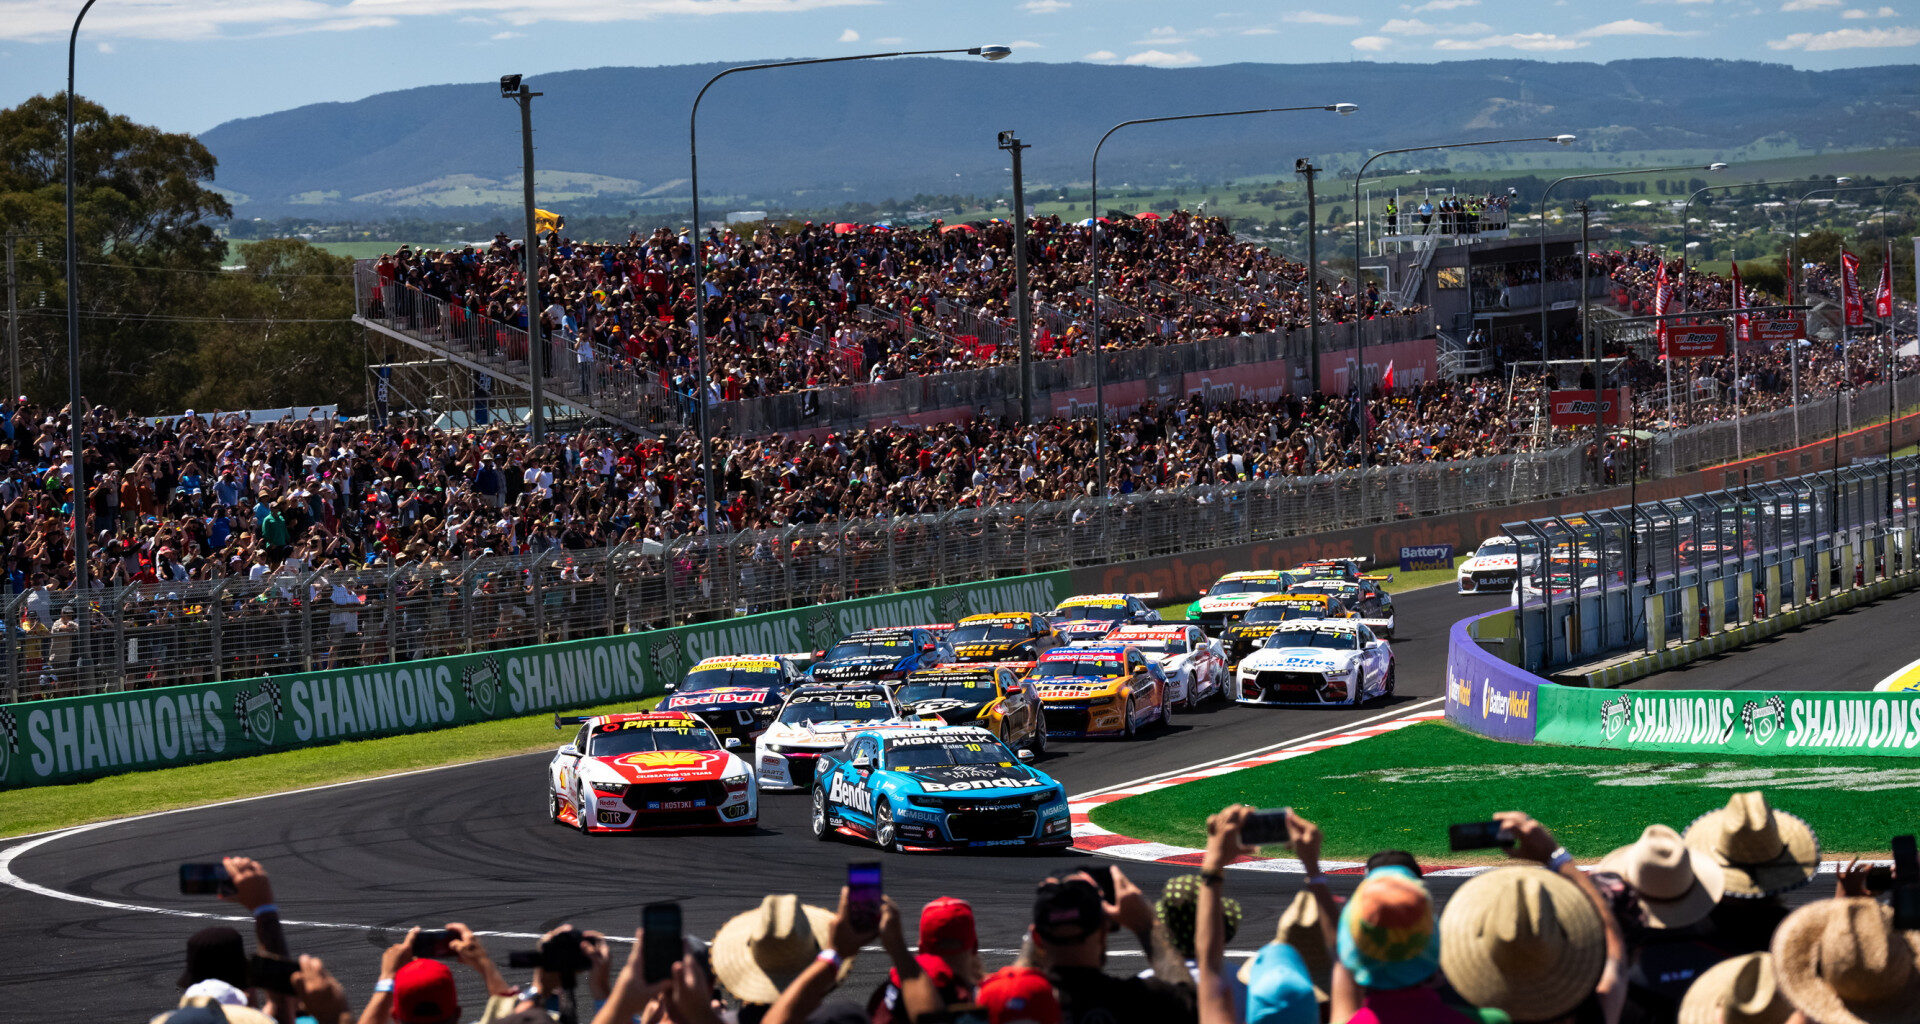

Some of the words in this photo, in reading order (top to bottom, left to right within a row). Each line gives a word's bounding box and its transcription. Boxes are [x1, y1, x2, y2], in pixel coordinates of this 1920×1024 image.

[1768, 322, 1798, 332] Repco
[1687, 333, 1717, 343] Repco
[1571, 400, 1611, 414] Repo
[1401, 547, 1449, 559] Battery
[1410, 559, 1448, 570] World
[839, 595, 937, 633] SHANNONS
[959, 617, 1012, 627] Steadfast
[1072, 624, 1112, 633] Bull
[1231, 625, 1279, 633] PENR
[1281, 624, 1350, 633] DAYCO
[686, 615, 801, 660] SHANNONS
[1286, 657, 1336, 666] Drive
[814, 665, 852, 675] SNOWY
[507, 641, 645, 713] SHANNONS
[792, 693, 883, 703] erebus
[1038, 690, 1091, 698] entals
[291, 664, 457, 741] SHANNONS
[669, 693, 718, 709] Red
[717, 692, 768, 704] Bull
[622, 719, 696, 730] PIRTEK
[1628, 697, 1735, 745] SHANNONS
[1785, 698, 1920, 748] SHANNONS
[28, 690, 227, 777] SHANNONS
[892, 735, 992, 747] MGMBULK
[965, 743, 981, 752] 10
[920, 777, 1042, 793] Bendix
[829, 771, 874, 815] Bendix
[729, 805, 746, 817] OTR
[974, 803, 1022, 812] Tyrepower
[600, 812, 621, 823] OTR
[896, 808, 941, 822] MGMBULK
